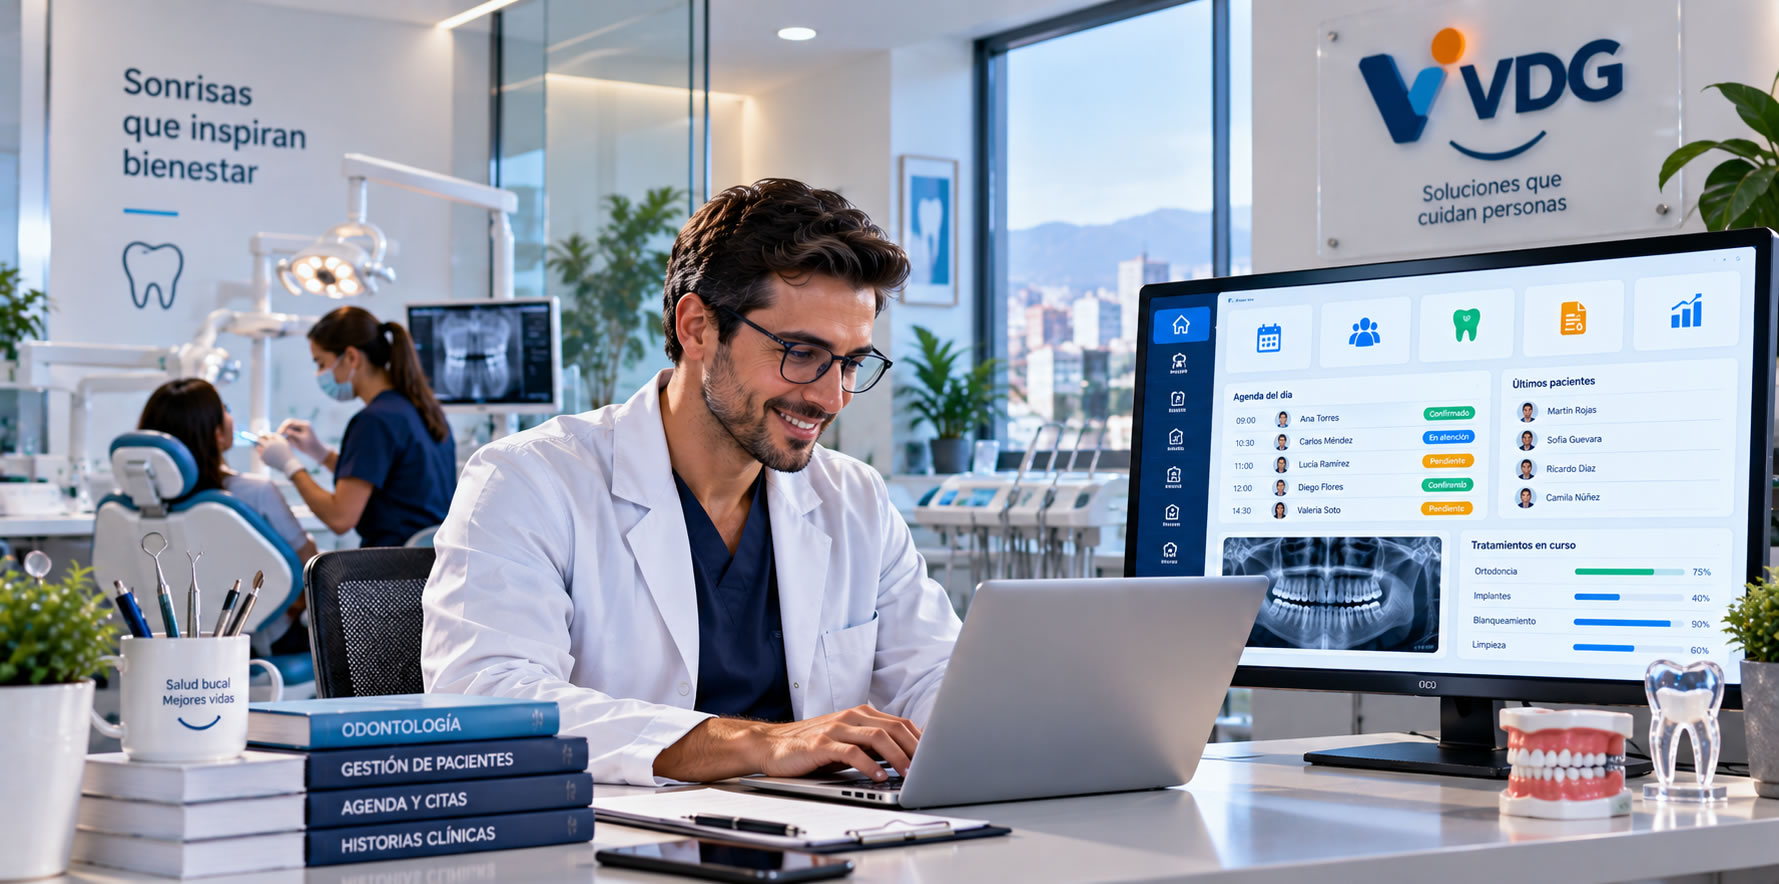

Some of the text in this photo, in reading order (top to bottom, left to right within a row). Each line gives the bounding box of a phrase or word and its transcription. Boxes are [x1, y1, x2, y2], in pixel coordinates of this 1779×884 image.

[1459, 38, 1624, 121] VDG
[123, 67, 253, 107] Sonrisas
[122, 113, 306, 152] que inspiran
[123, 146, 259, 185] bienestar
[1423, 172, 1563, 202] Soluciones que
[1417, 194, 1568, 225] cuidan personas
[1549, 376, 1596, 390] pacientes
[1233, 391, 1264, 403] Agenda
[1265, 390, 1279, 400] del
[1574, 406, 1598, 417] Rojas
[1299, 414, 1340, 423] Ana Torres
[1299, 436, 1354, 446] Carlos Méndez
[1429, 433, 1438, 441] En
[1568, 435, 1603, 444] Guevara
[1235, 439, 1255, 448] 10:30
[1234, 461, 1254, 470] 11:00
[1546, 464, 1577, 474] Ricardo
[1297, 482, 1344, 494] Diego Flores
[1545, 493, 1574, 502] Camila
[1297, 505, 1342, 515] Valeria Soto
[1471, 540, 1577, 550] Tratamientos en curso
[1474, 566, 1518, 576] Ortodoncia
[1692, 567, 1712, 577] 75%
[1473, 591, 1512, 602] Implantes
[1691, 594, 1711, 603] 40%
[1472, 615, 1537, 627] Blanqueamiento
[1691, 619, 1711, 629] 90%
[1472, 640, 1507, 651] Limpieza
[1690, 646, 1710, 655] 60%
[165, 677, 231, 691] Salud bucal
[162, 692, 235, 709] Mejores vidas
[341, 713, 462, 738] ODONTOLOGÍA
[341, 752, 514, 777] GESTIÓN DE PACIENTES
[341, 792, 468, 816] AGENDA Y CITAS
[341, 826, 496, 853] HISTORIAS CLÍNICAS
